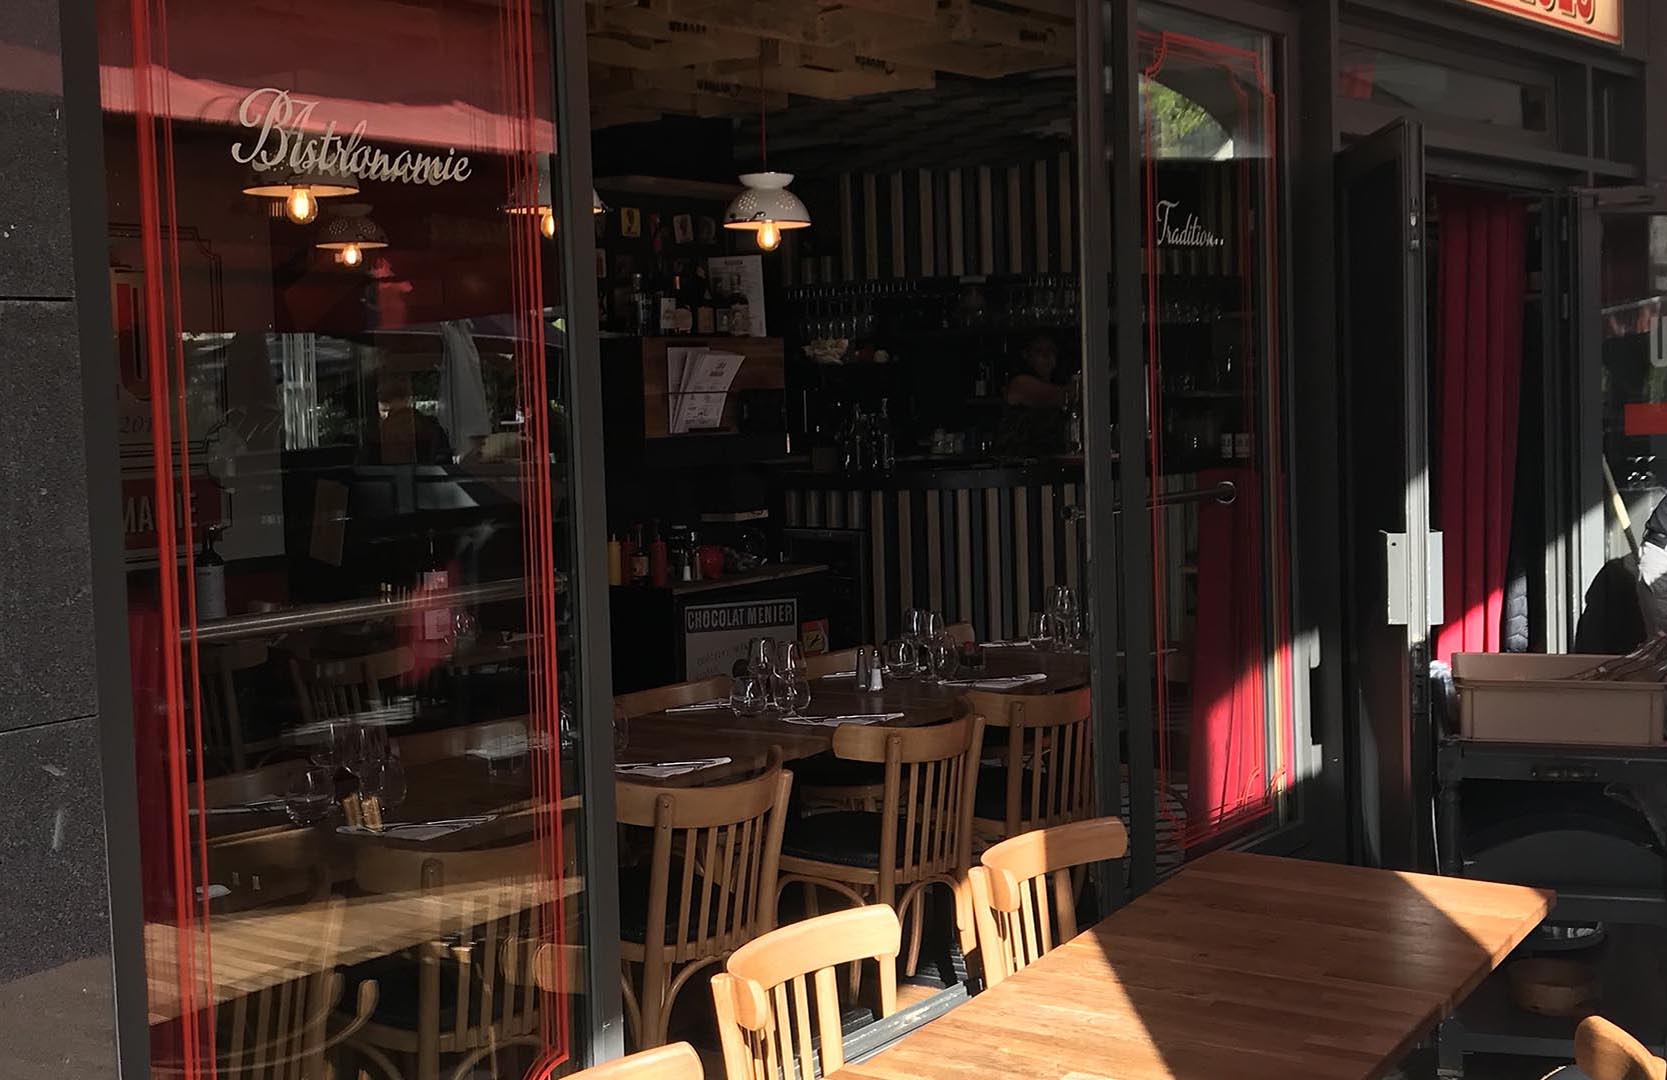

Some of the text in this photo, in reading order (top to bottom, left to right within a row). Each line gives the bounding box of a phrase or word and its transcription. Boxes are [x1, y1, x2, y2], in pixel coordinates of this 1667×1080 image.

[231, 88, 471, 182] Bistronomie
[687, 603, 794, 630] CHOCOLAT MENIER
